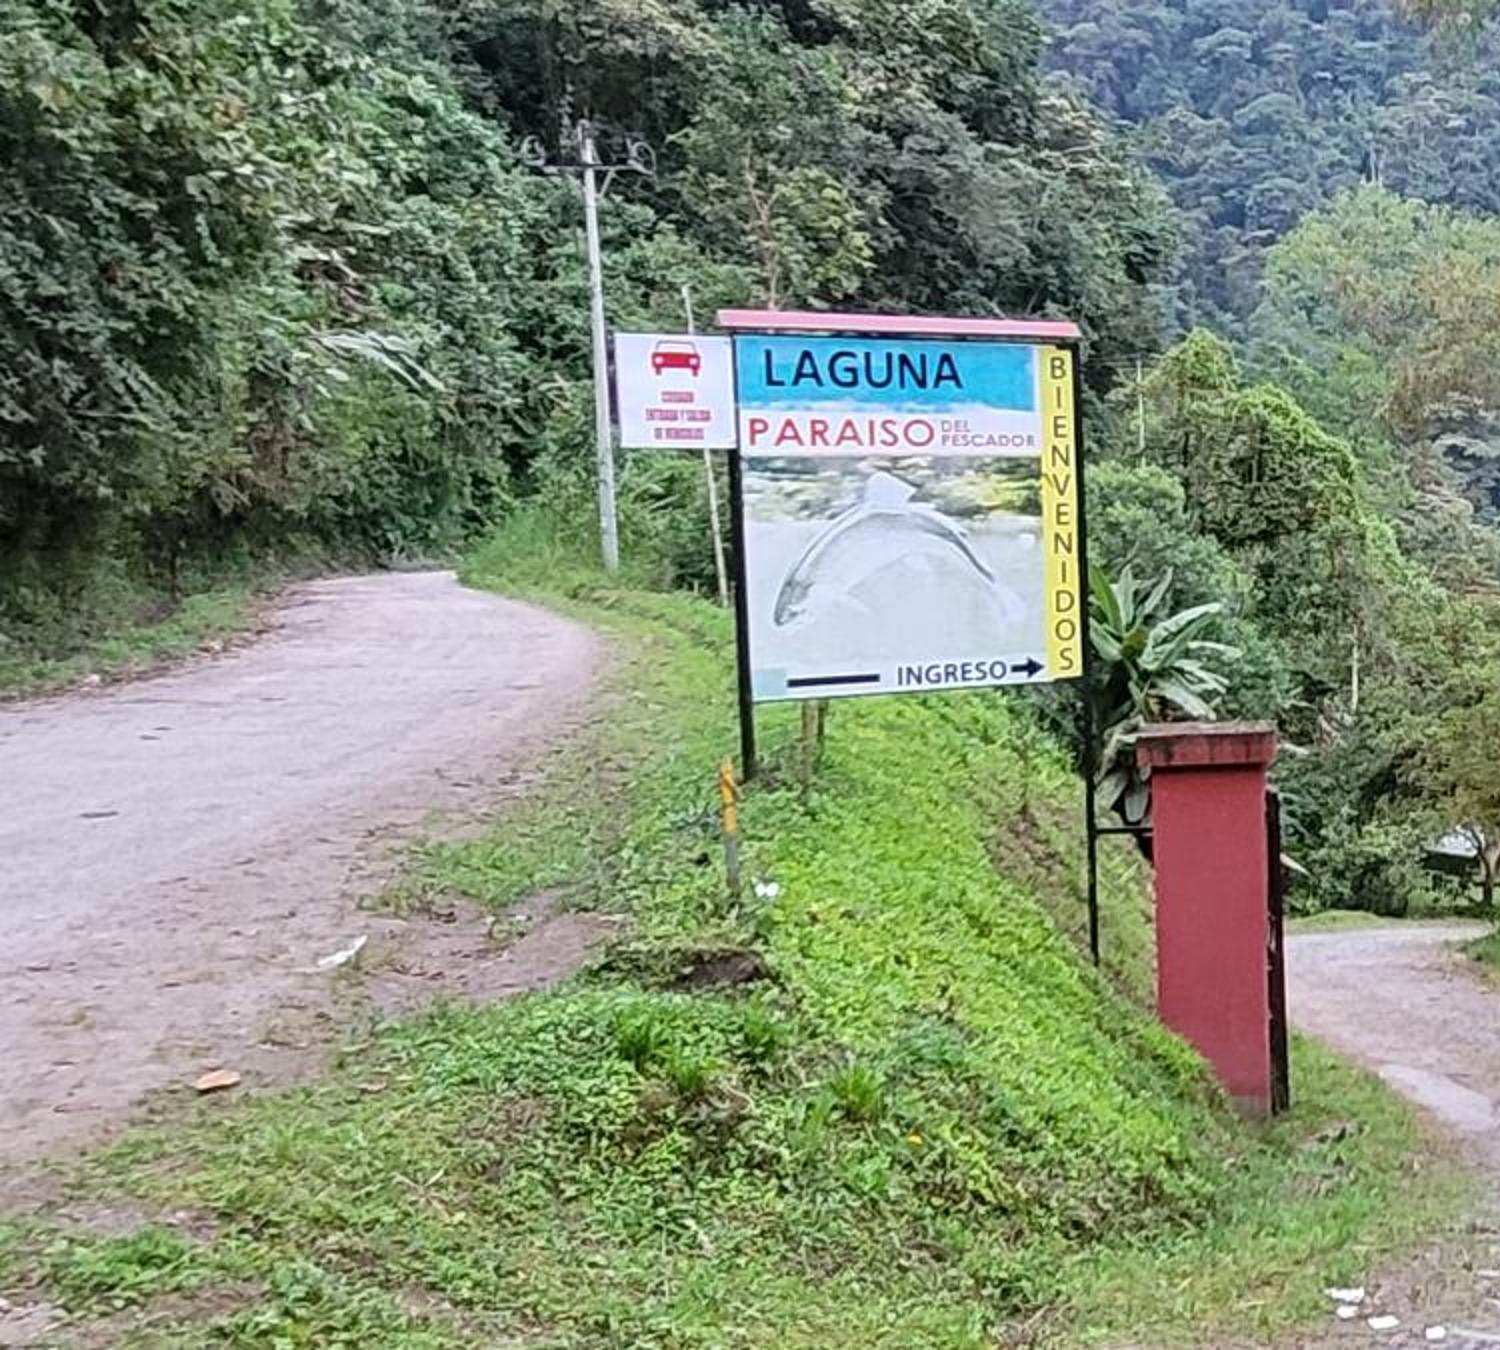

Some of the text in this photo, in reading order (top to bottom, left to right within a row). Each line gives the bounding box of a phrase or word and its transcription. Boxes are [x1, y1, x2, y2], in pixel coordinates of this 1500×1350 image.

[764, 348, 963, 389] LAGUNA
[749, 418, 935, 447] PARAISO
[941, 419, 971, 433] DEL
[941, 434, 1035, 448] PESCADOR
[1050, 357, 1076, 671] BIENVENIDOS
[897, 660, 1008, 686] INGRESO
